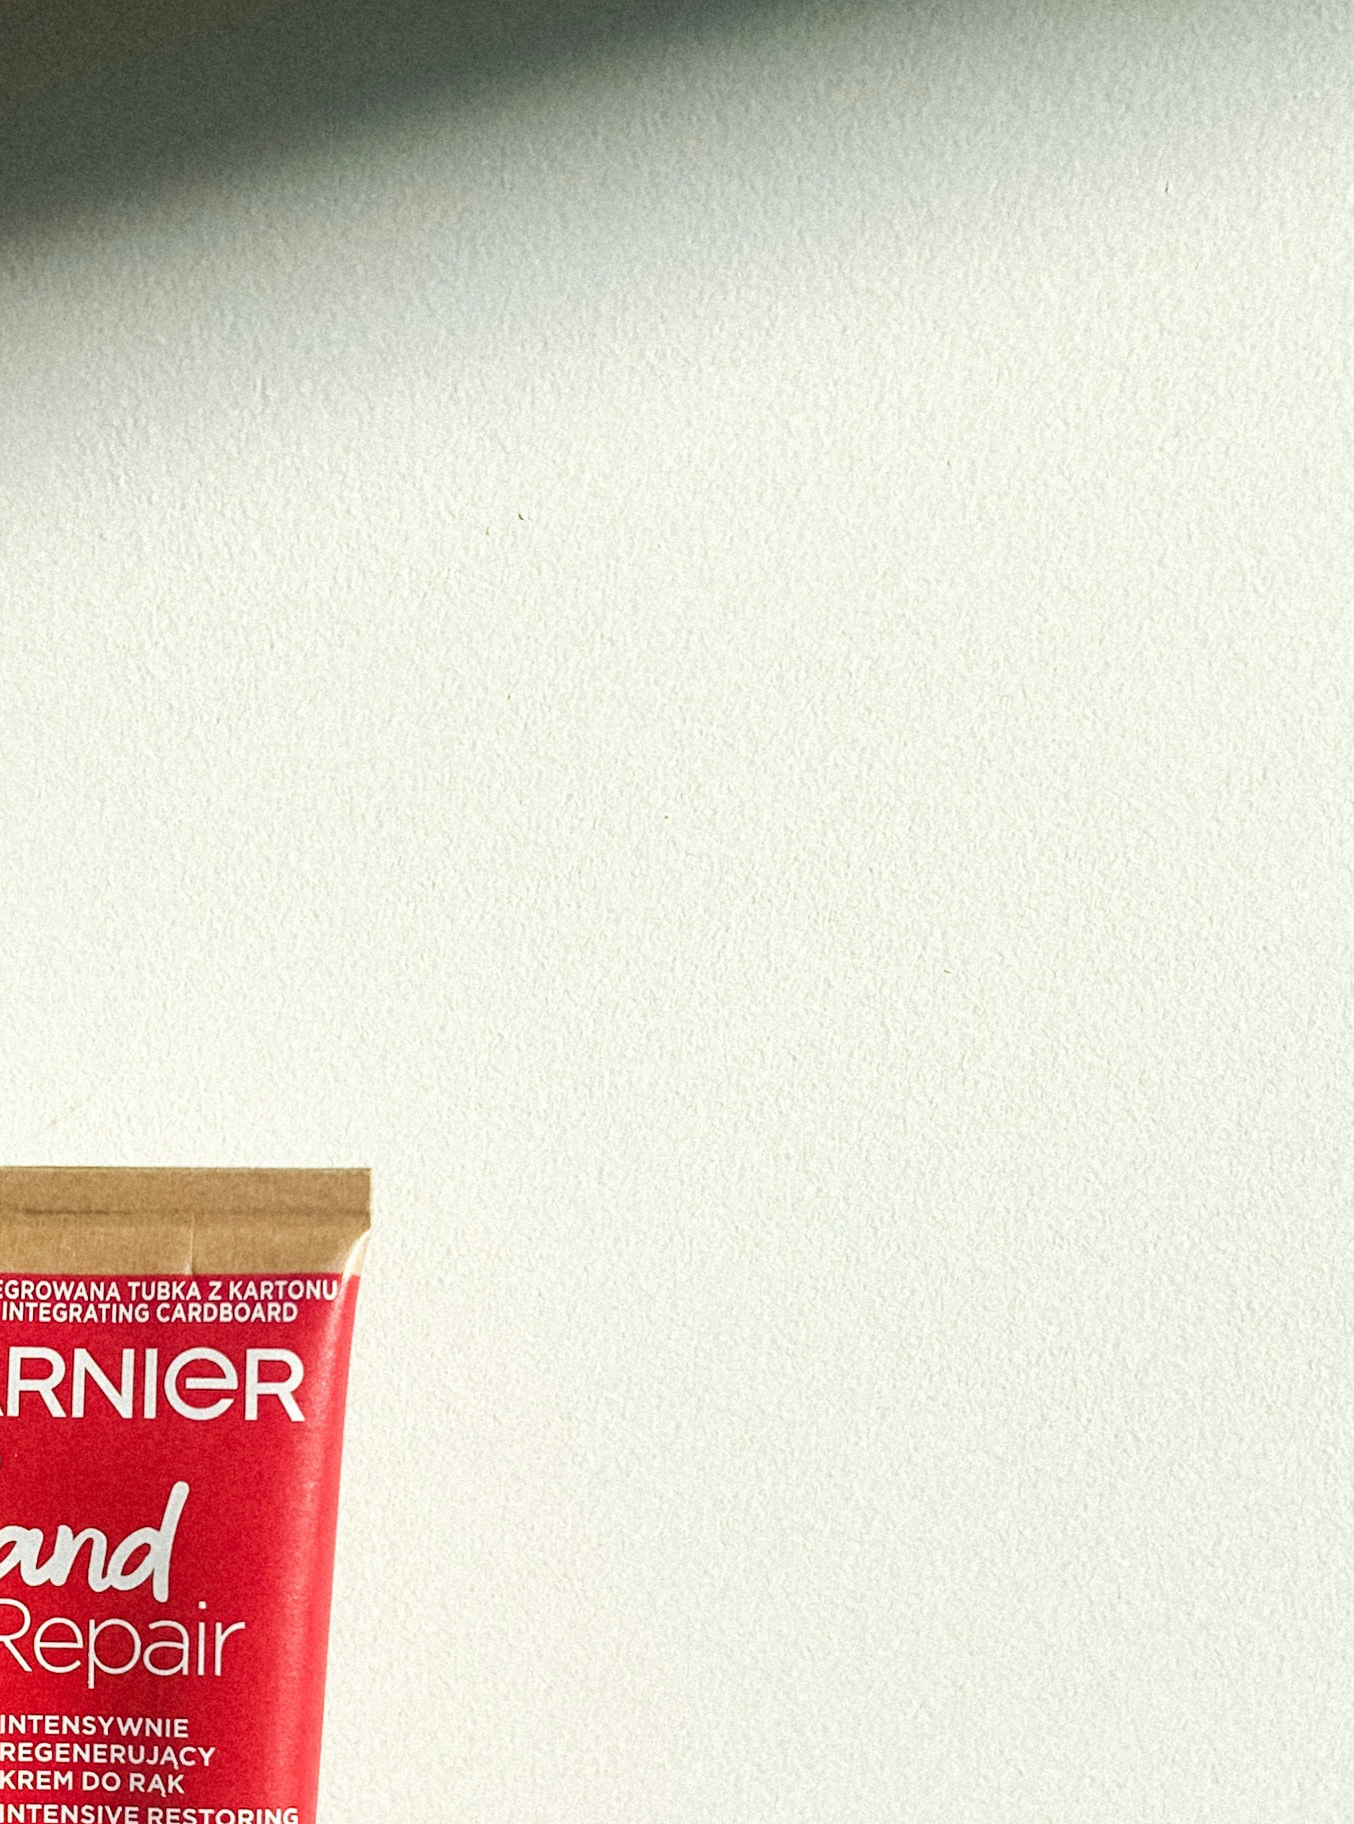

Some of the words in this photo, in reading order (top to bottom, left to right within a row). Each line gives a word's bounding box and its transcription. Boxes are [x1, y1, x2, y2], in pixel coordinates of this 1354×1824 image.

[128, 1281, 202, 1301] TUBKA
[209, 1281, 223, 1301] Z
[229, 1280, 339, 1302] KARTONU
[1, 1301, 149, 1324] INTEGRATING
[156, 1302, 298, 1323] CARDBOARD
[0, 1714, 189, 1739] INTENSYWNIE
[0, 1742, 216, 1770] REGENERUJĄCY
[0, 1771, 73, 1792] KREM
[81, 1772, 121, 1793] DO
[130, 1774, 185, 1798] RĄK
